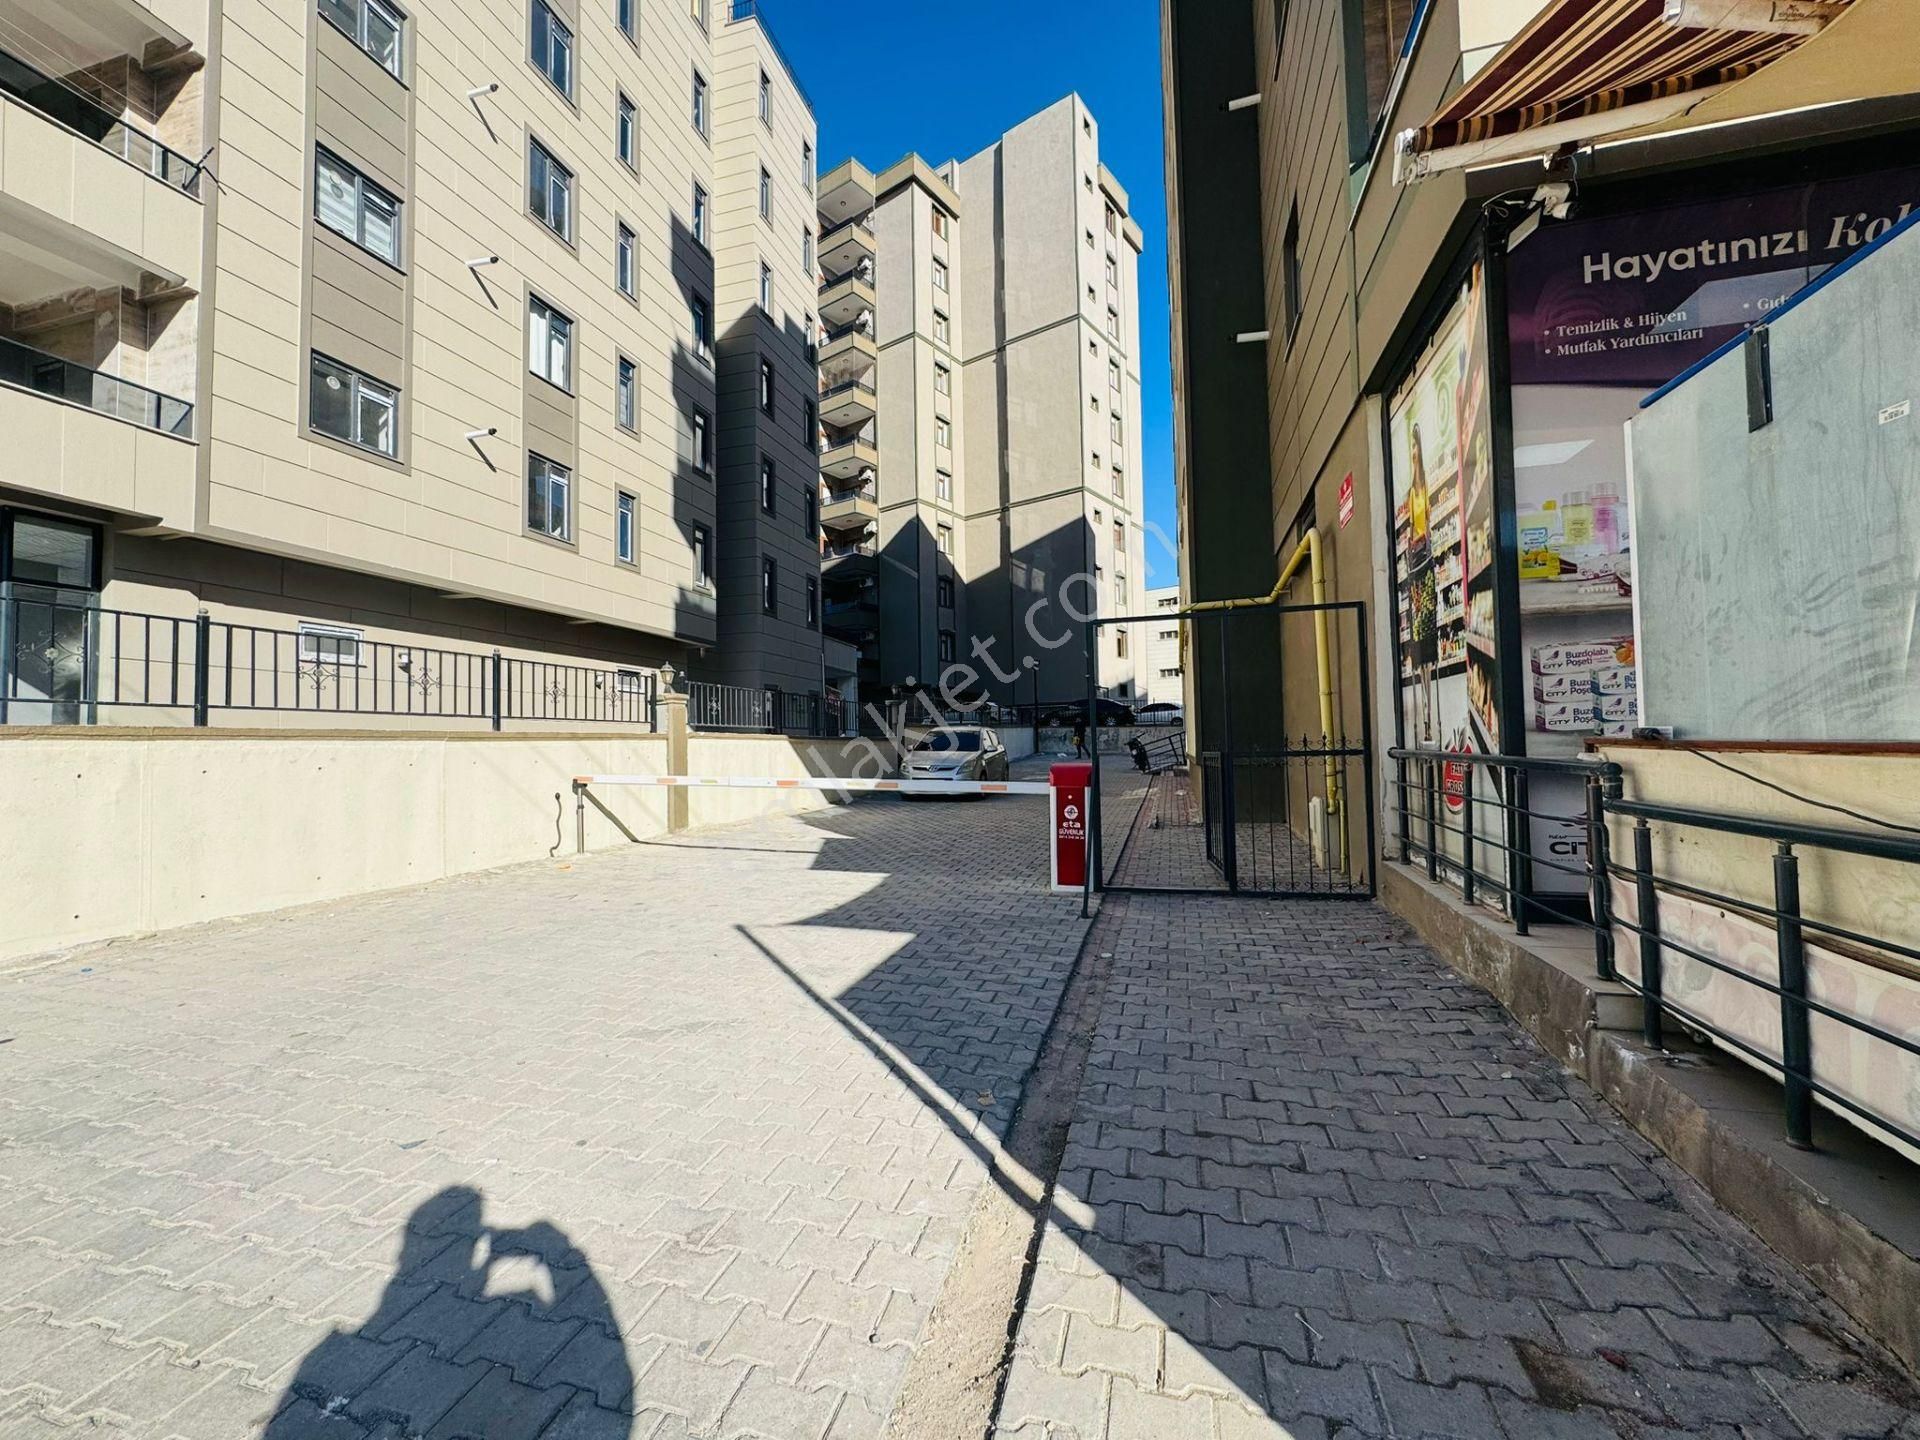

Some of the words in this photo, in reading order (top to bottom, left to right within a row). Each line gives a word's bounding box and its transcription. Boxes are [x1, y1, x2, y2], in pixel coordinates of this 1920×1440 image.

[1583, 229, 1808, 284] Hayatınızı
[1757, 294, 1791, 310] Gıd
[1556, 317, 1620, 337] Temizlik
[1623, 317, 1634, 329] &
[1638, 310, 1687, 326] Hijyen
[1556, 339, 1607, 356] Mutfak
[1610, 328, 1704, 349] Yardımcıları
[1545, 690, 1567, 698] CITY
[1062, 820, 1081, 829] eta
